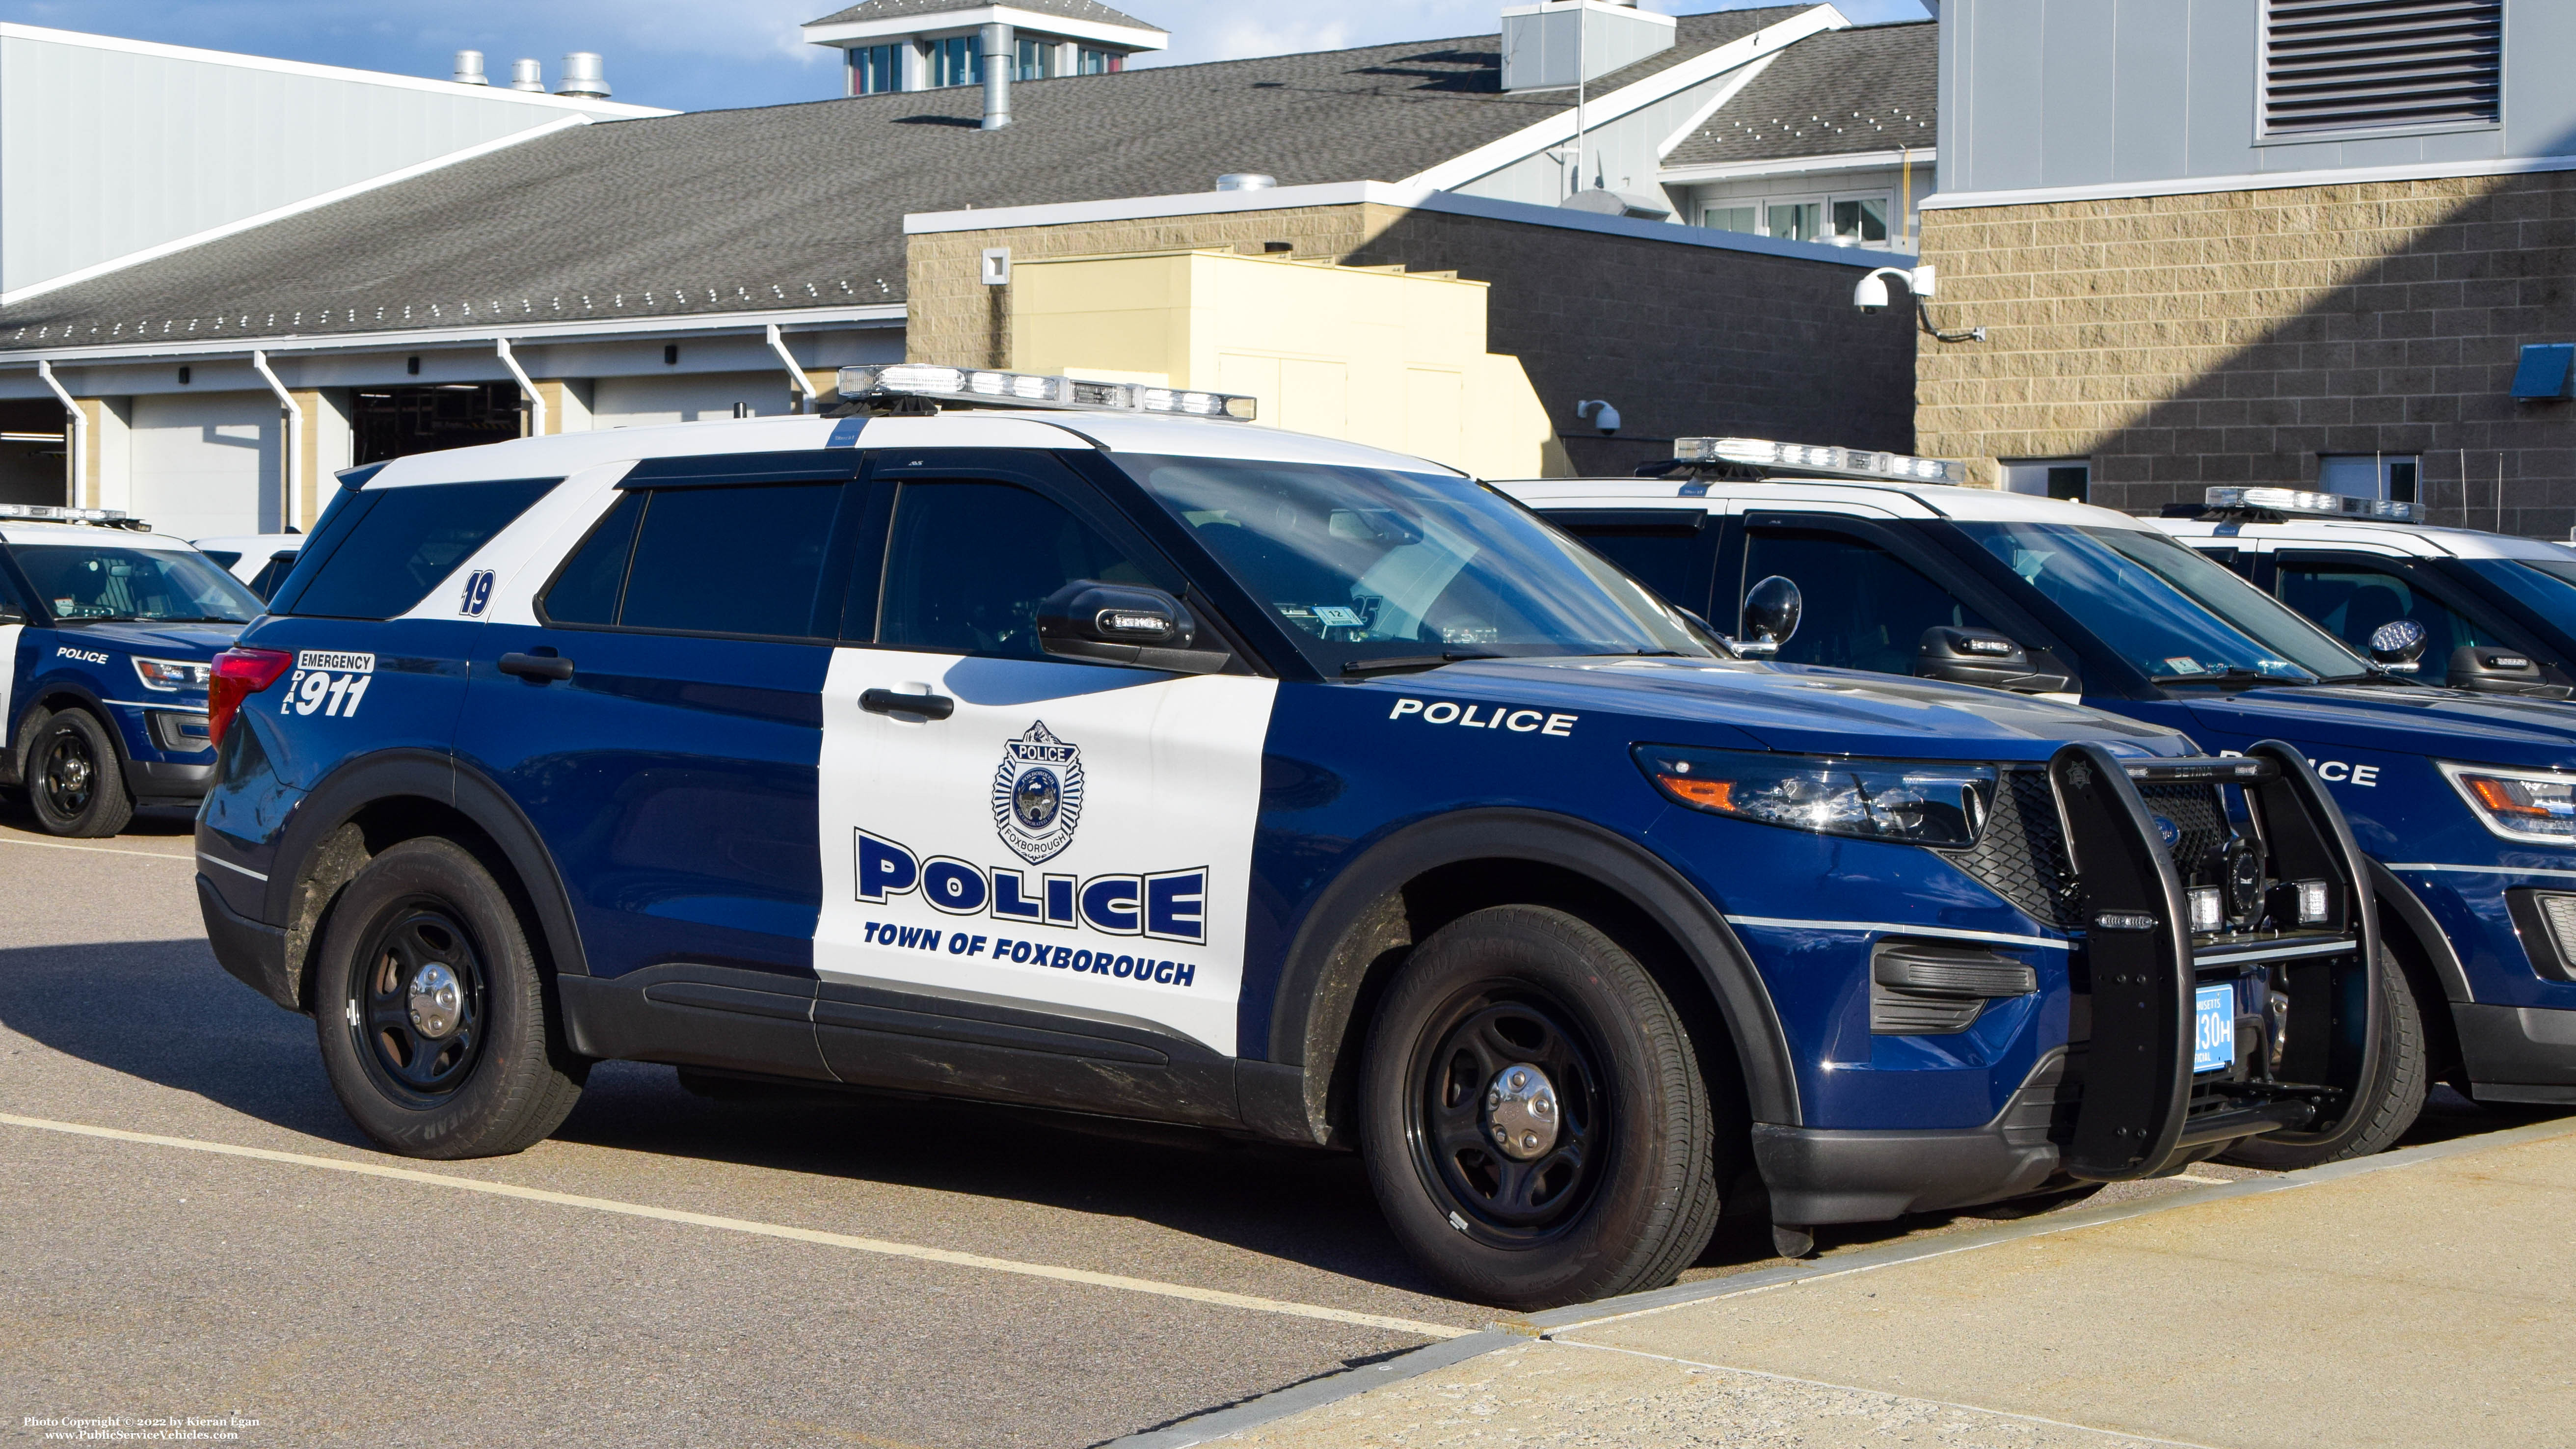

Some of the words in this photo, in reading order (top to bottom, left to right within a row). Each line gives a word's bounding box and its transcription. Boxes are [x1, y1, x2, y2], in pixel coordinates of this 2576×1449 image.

[459, 569, 496, 618] 19
[56, 647, 109, 664] POLICE
[301, 653, 371, 670] EMERGENCY
[280, 670, 305, 714] DIAL
[296, 671, 372, 717] 911
[1389, 698, 1579, 736] POLICE
[1019, 745, 1066, 761] POLICE
[1021, 771, 1055, 784] FOXBOROUGH
[1004, 828, 1066, 853] FOXBOROUGH
[854, 826, 1209, 946] POLICE
[864, 921, 941, 951] TOWN
[948, 932, 988, 957] OF
[992, 938, 1196, 987] FOXBOROUGH
